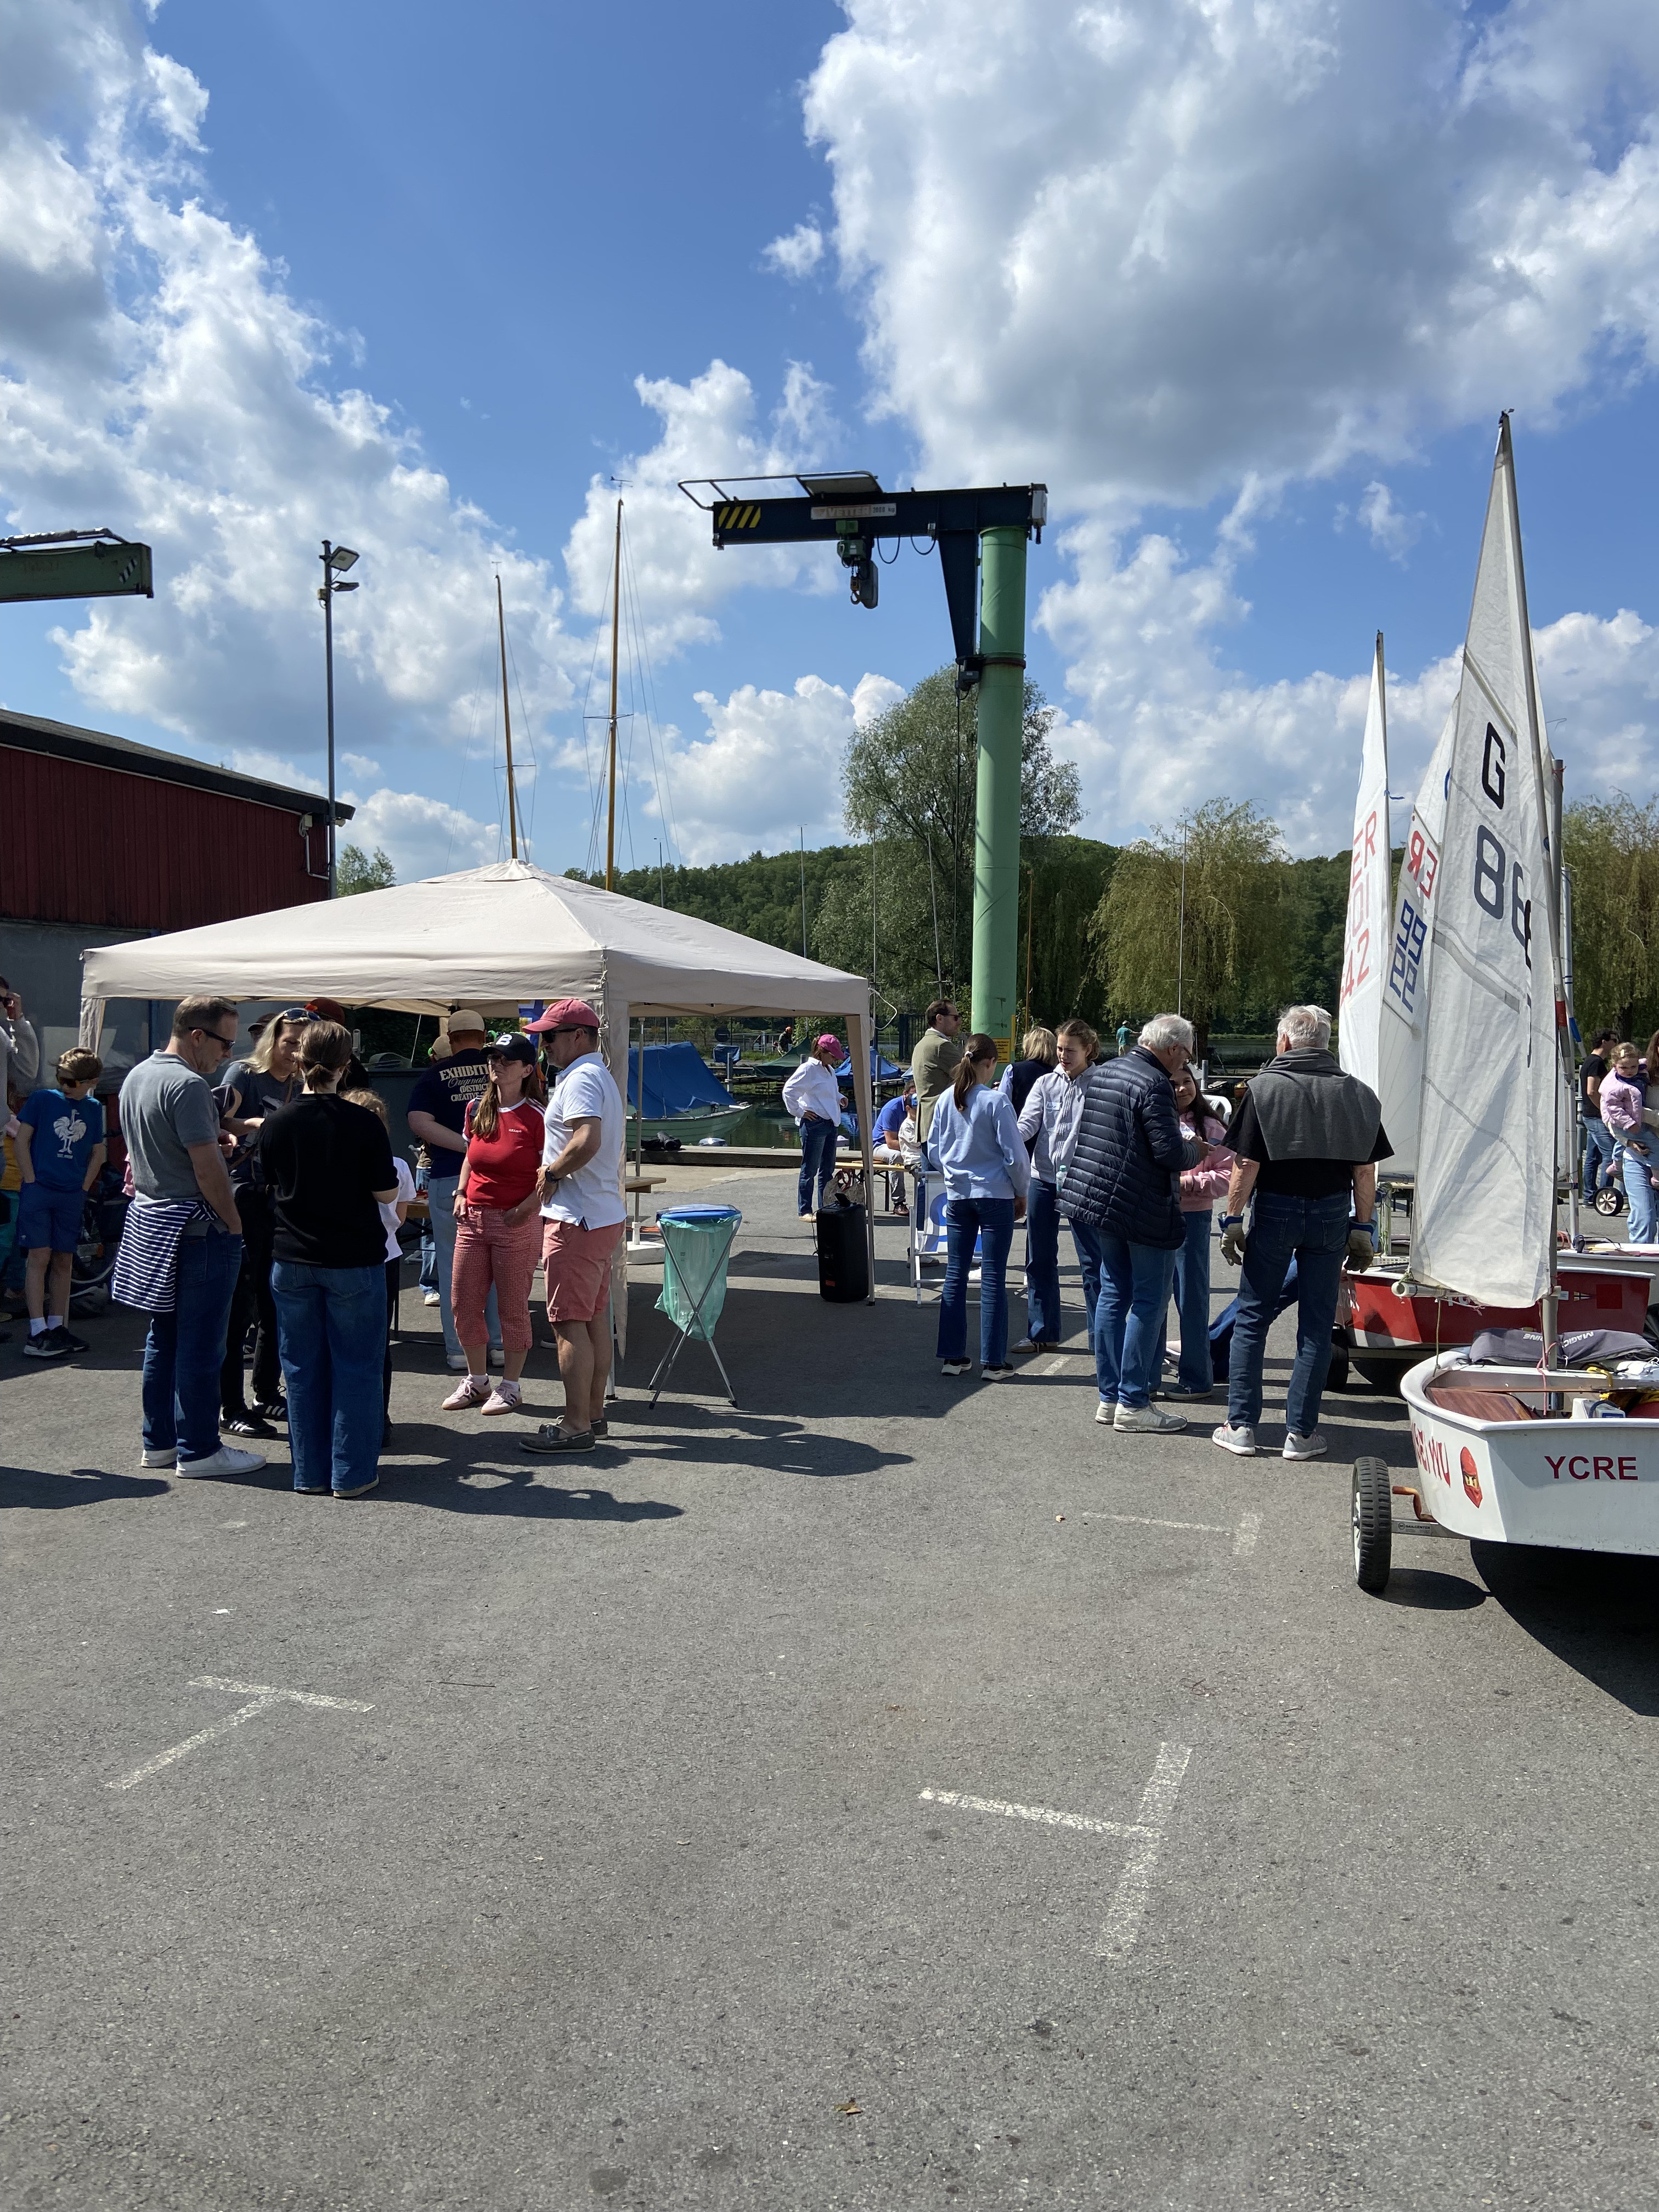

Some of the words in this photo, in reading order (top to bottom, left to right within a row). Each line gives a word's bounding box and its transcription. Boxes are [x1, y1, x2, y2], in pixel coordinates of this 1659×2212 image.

[1481, 721, 1505, 810] G
[1339, 928, 1369, 1009] 42
[495, 1034, 512, 1046] B
[1544, 1455, 1638, 1481] YCRE
